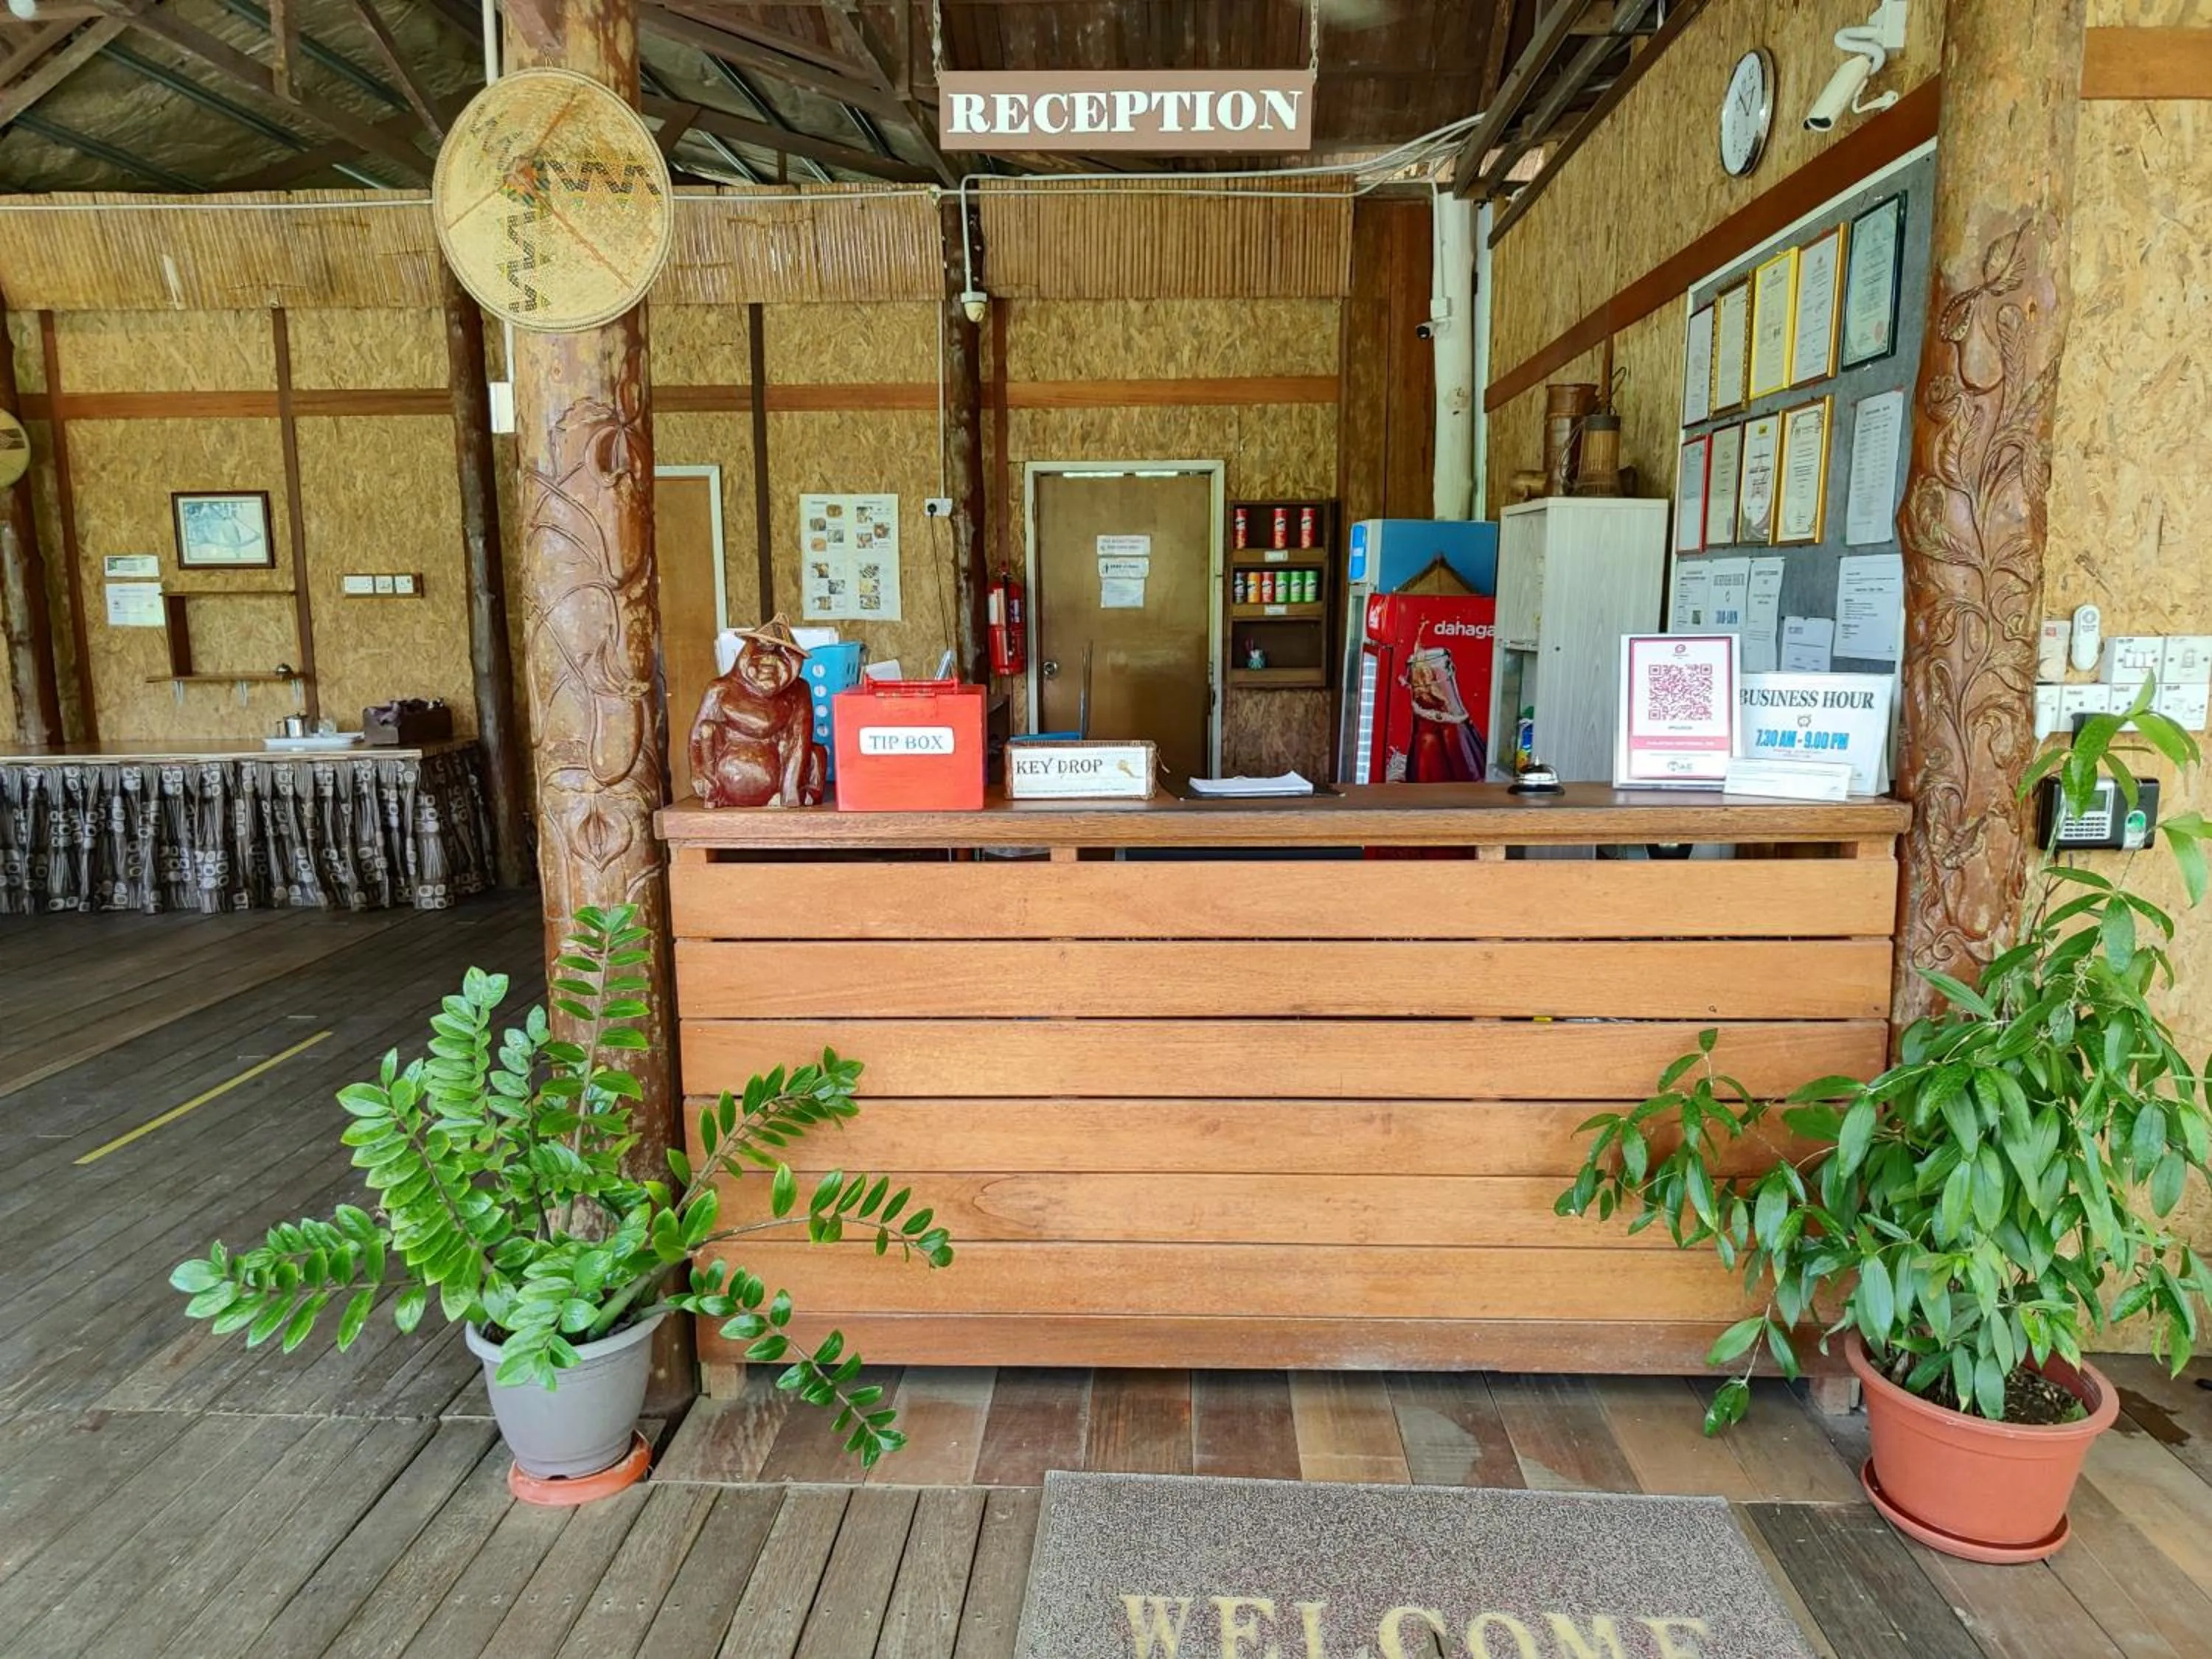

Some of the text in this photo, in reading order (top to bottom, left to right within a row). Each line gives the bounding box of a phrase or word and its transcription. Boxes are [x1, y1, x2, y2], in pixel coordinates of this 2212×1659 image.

[947, 89, 1303, 134] RECEPTION
[1434, 620, 1495, 639] dahaga
[1821, 690, 1874, 709] HOUR
[869, 735, 943, 749] TIP BOX
[1779, 730, 1797, 748] AM
[1830, 732, 1850, 751] PM
[1017, 758, 1103, 775] KEY DROP
